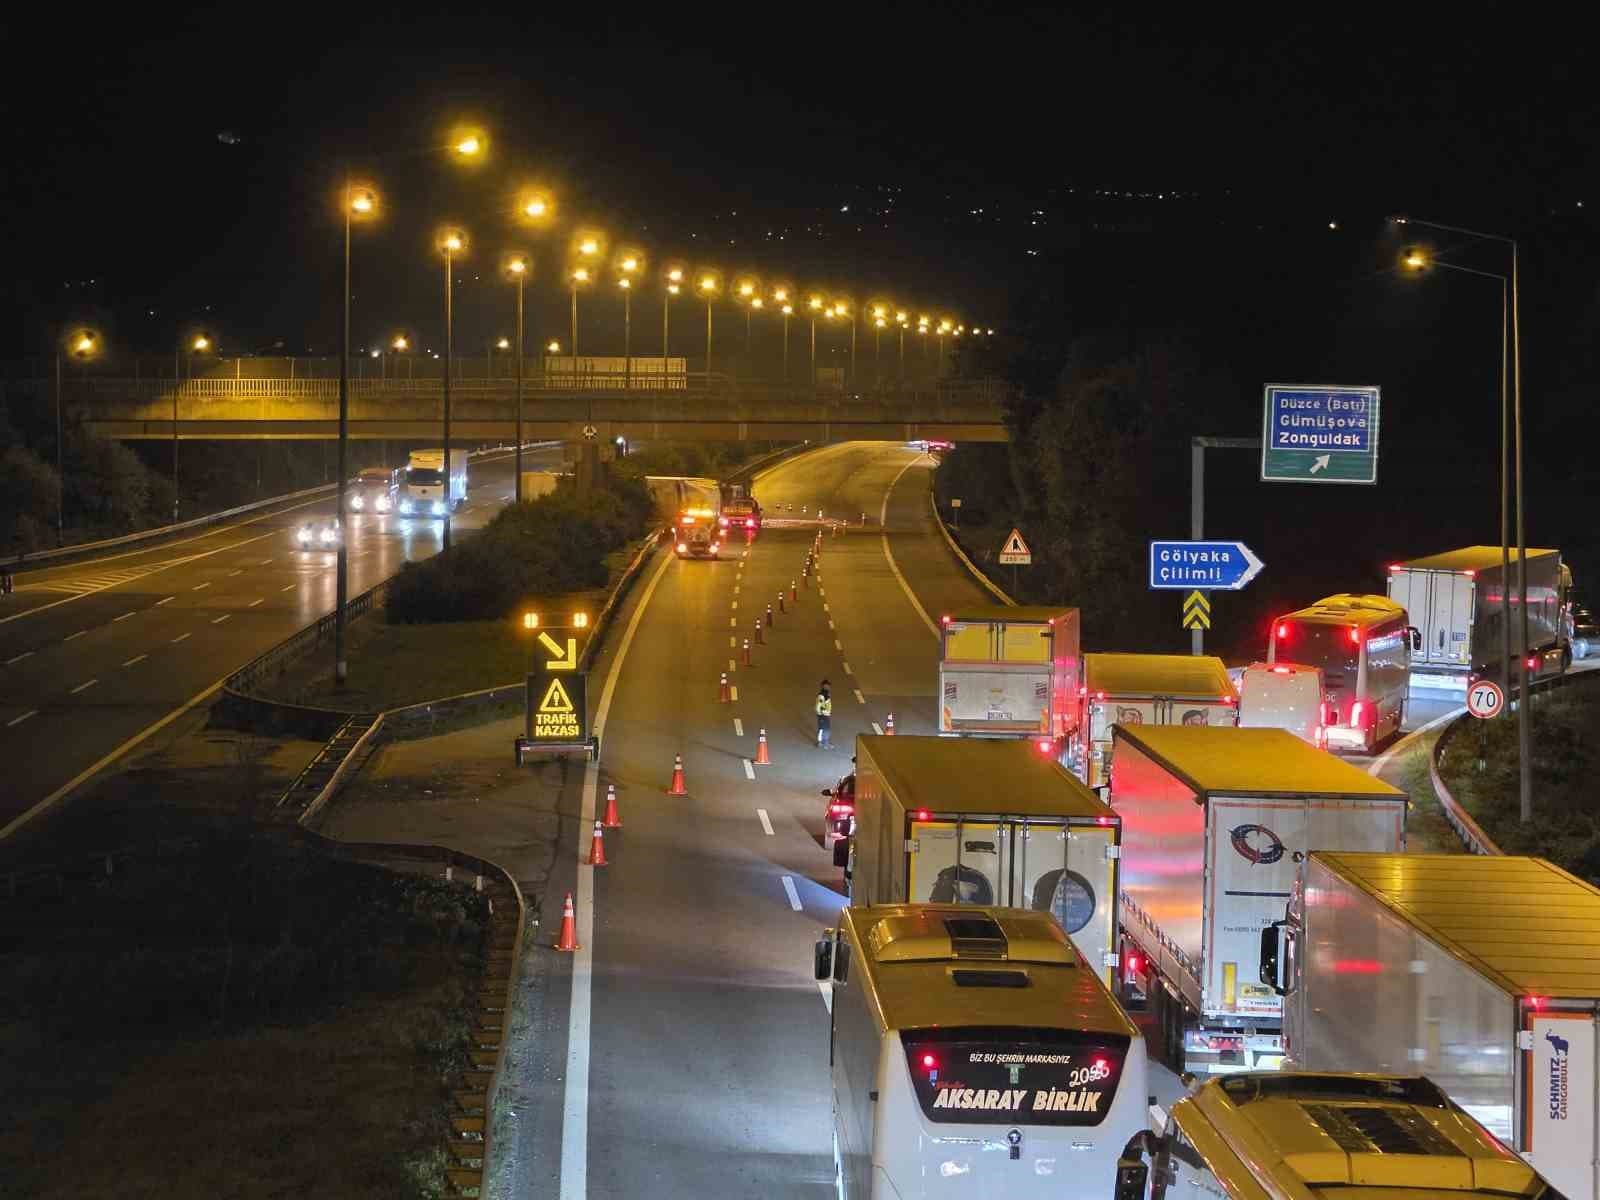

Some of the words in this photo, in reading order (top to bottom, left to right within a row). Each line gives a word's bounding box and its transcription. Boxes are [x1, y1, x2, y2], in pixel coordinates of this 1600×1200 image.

[1280, 398, 1321, 409] Düzce
[1280, 414, 1367, 430] Gümüşova
[1279, 432, 1361, 447] Zonguldak
[1160, 549, 1230, 565] Gölyaka
[1160, 567, 1221, 581] Çilimli
[1475, 691, 1496, 708] 70
[535, 711, 577, 725] TRAFİK
[535, 725, 580, 737] KAZASI
[984, 1053, 996, 1063] BU
[1550, 1057, 1560, 1121] SCHMITZ
[933, 1088, 1028, 1111] AKSARAY
[1032, 1086, 1102, 1112] BİRLİK
